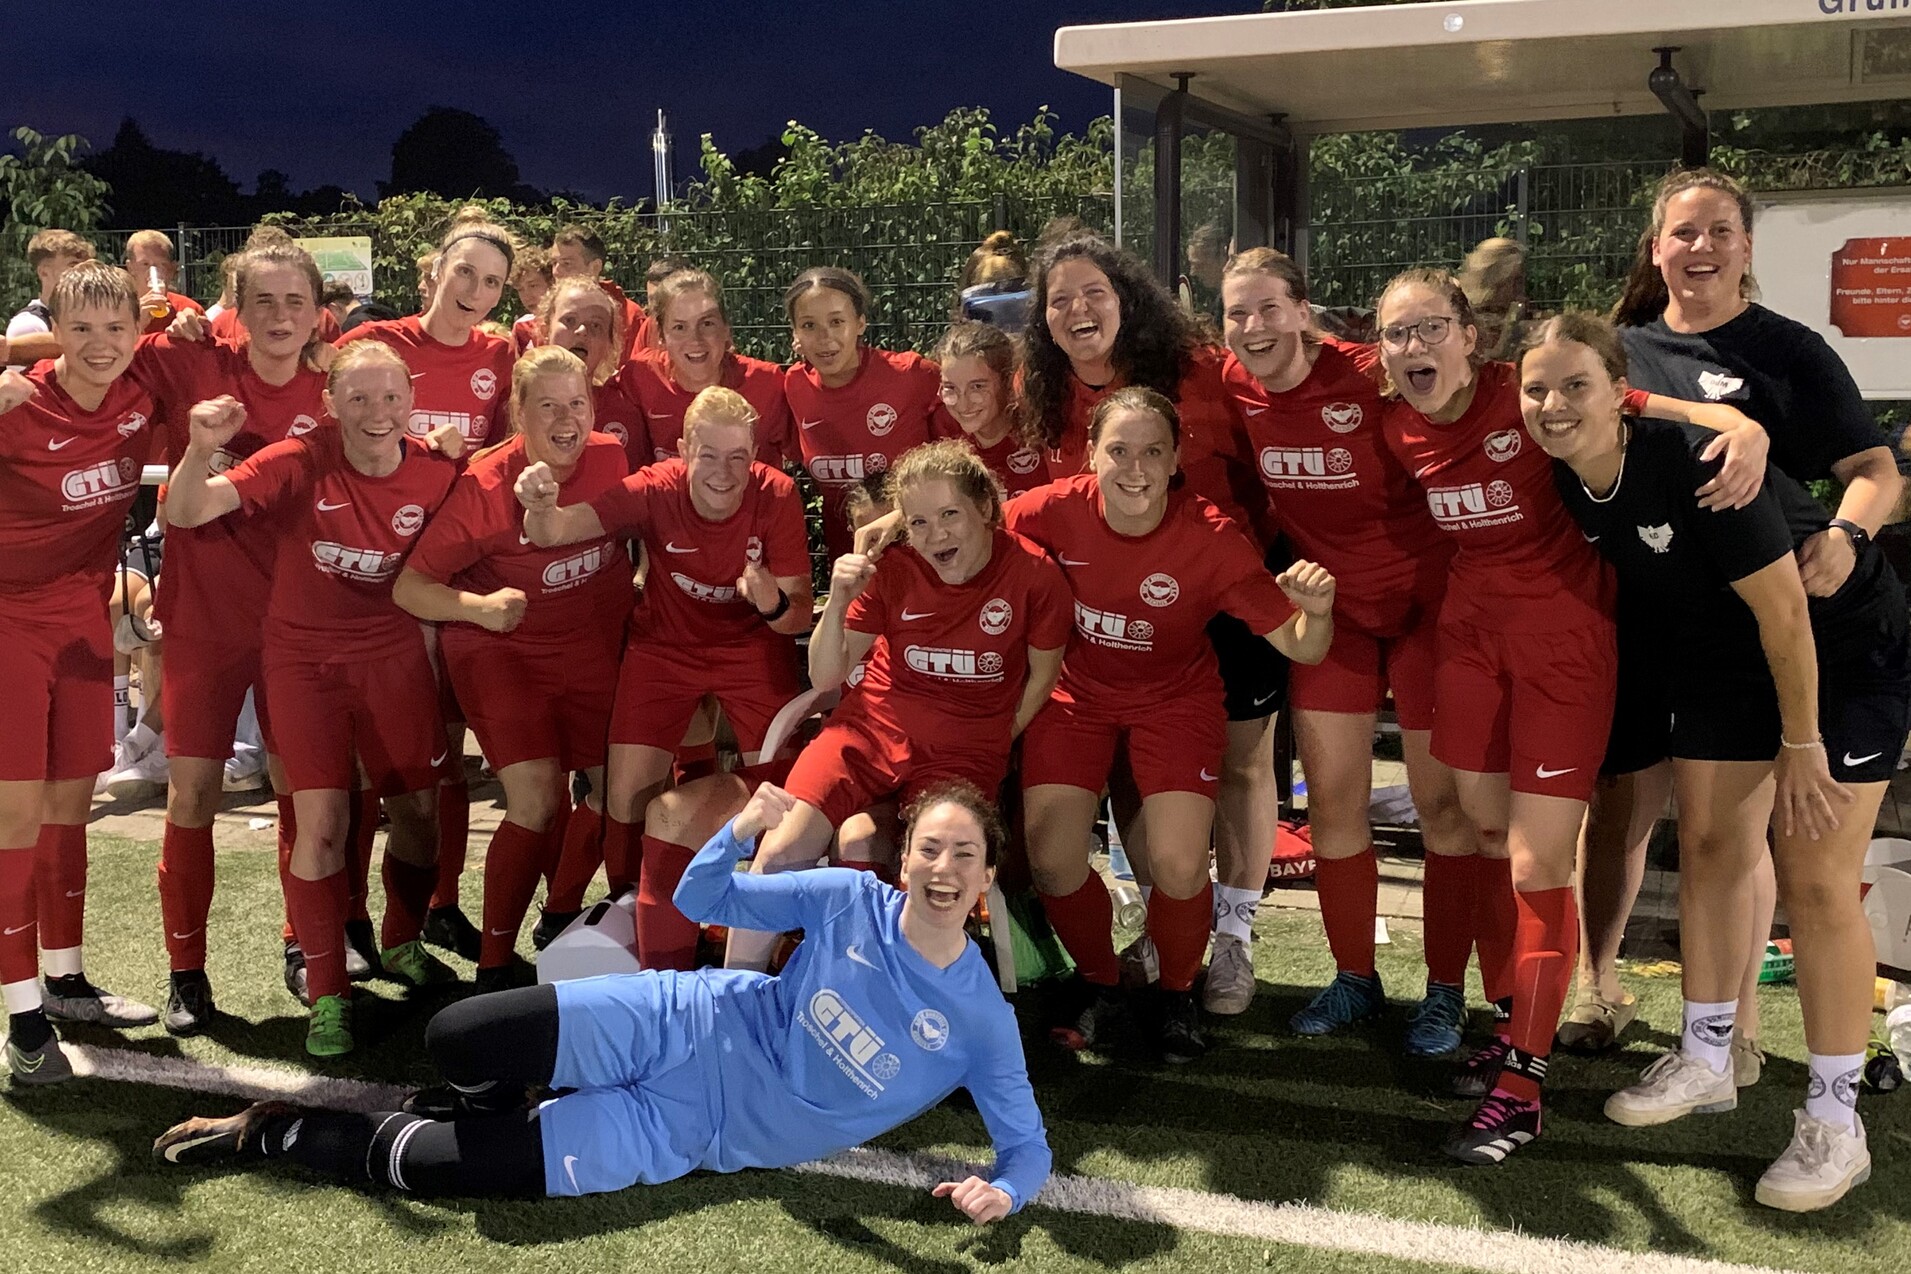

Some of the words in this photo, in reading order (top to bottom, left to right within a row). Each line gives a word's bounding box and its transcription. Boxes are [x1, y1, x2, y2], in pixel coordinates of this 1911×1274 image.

[1297, 481, 1304, 490] &
[1305, 479, 1360, 491] Holthenrich
[97, 495, 104, 505] &
[1461, 521, 1468, 530] &
[1469, 511, 1524, 530] Holthenrich
[1075, 600, 1127, 639] TÜ
[1089, 636, 1097, 645] &
[1098, 638, 1153, 652] Holthenrich
[796, 1010, 829, 1049] Troschel
[825, 1046, 835, 1058] &
[832, 1053, 879, 1101] Holthenrich
